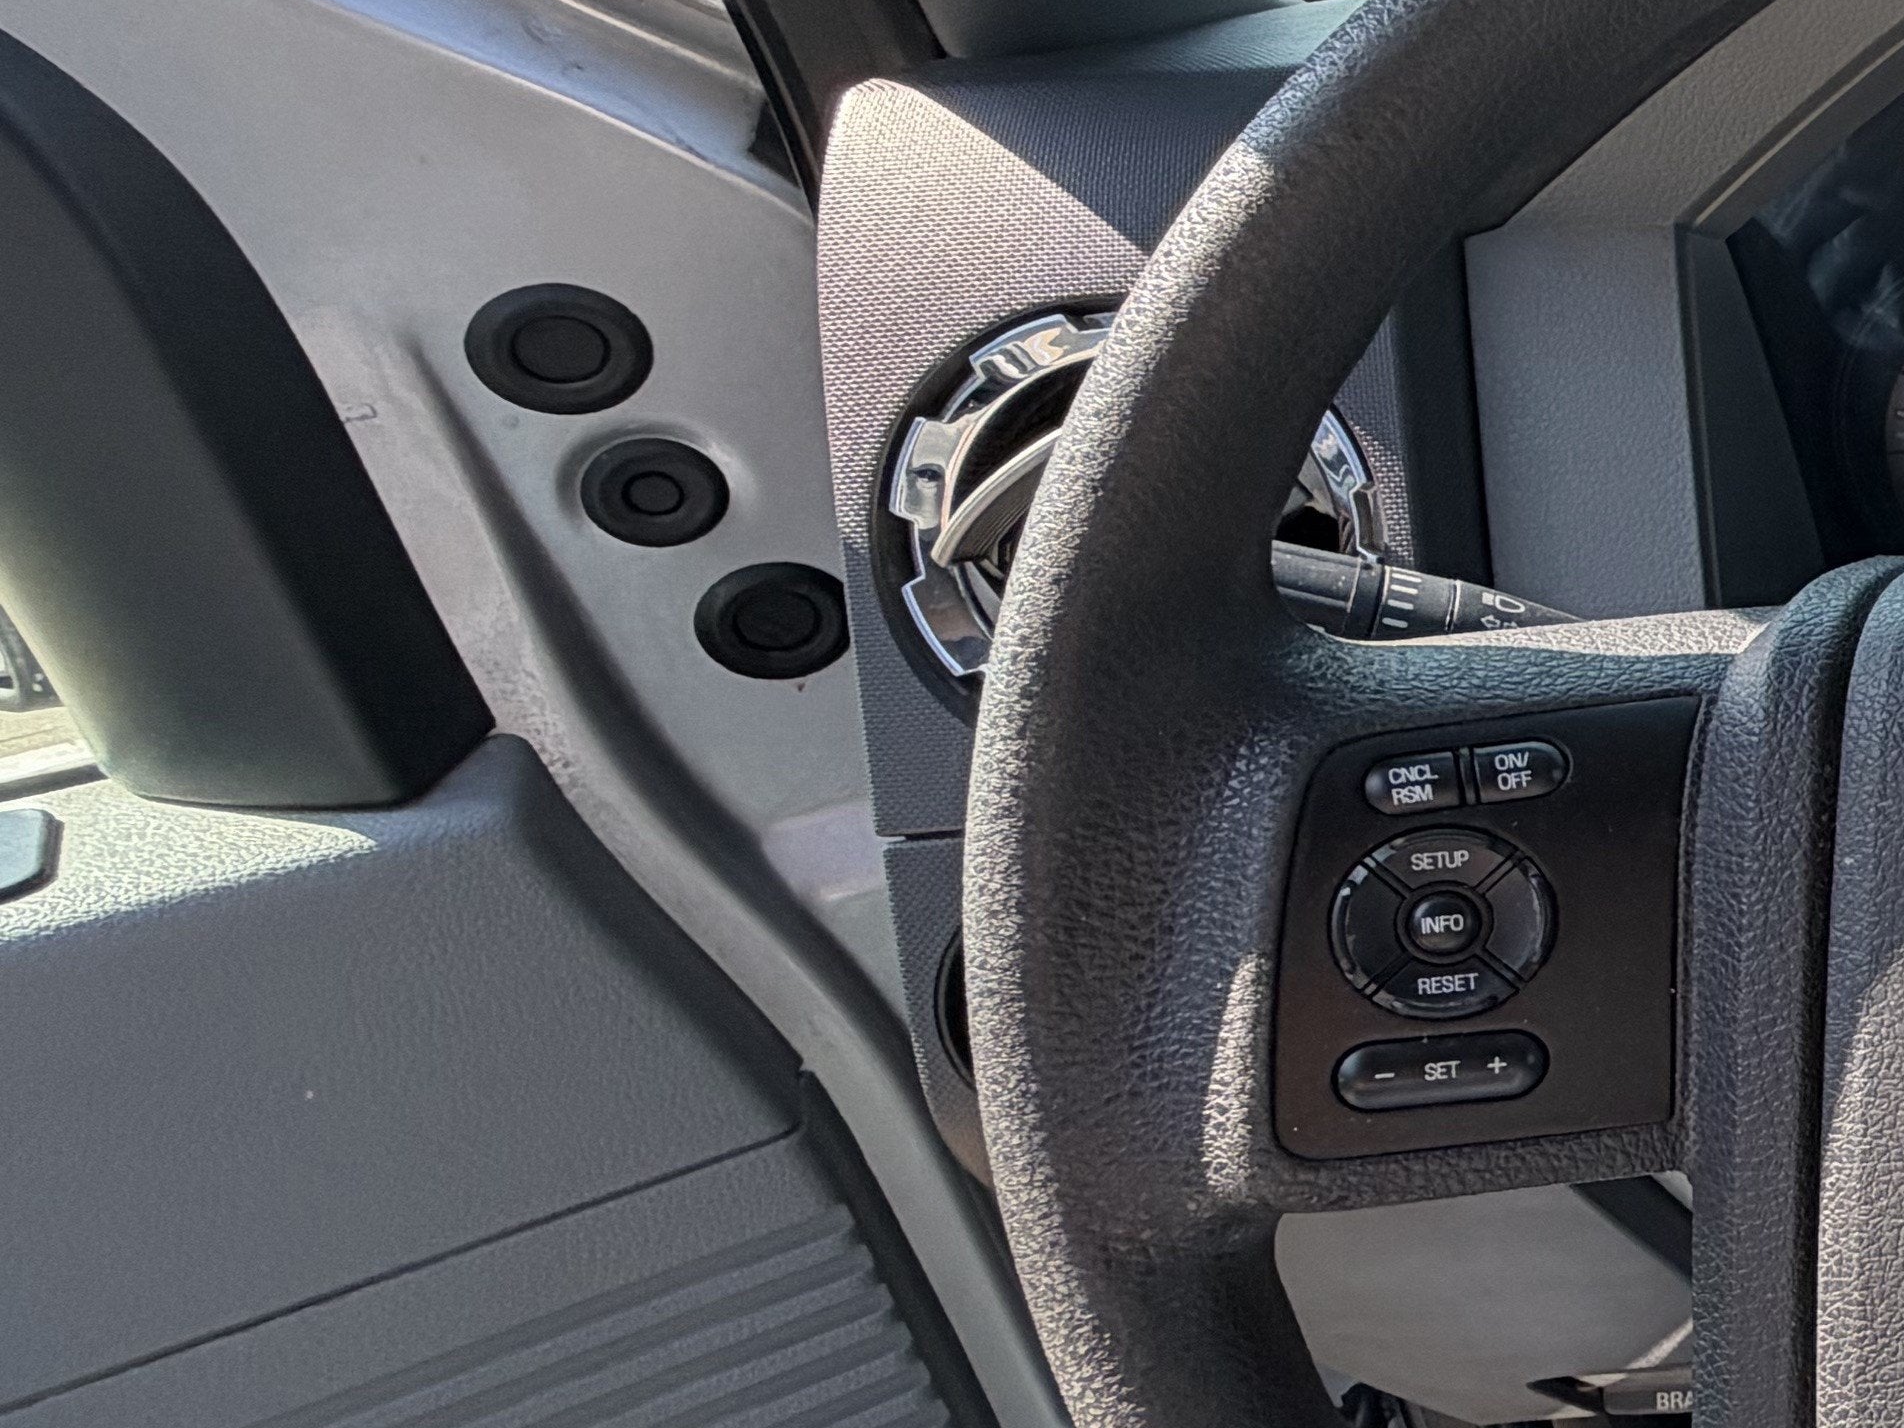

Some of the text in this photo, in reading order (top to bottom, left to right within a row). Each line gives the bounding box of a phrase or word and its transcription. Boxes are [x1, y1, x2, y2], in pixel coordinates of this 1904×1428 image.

[1493, 752, 1531, 771] ON/
[1387, 764, 1439, 785] CNCL
[1497, 771, 1533, 791] OFF
[1392, 785, 1434, 807] RSM
[1410, 849, 1470, 872] SETUP
[1420, 913, 1465, 935] INFO
[1417, 972, 1479, 996] RESET
[1423, 1060, 1461, 1082] SET
